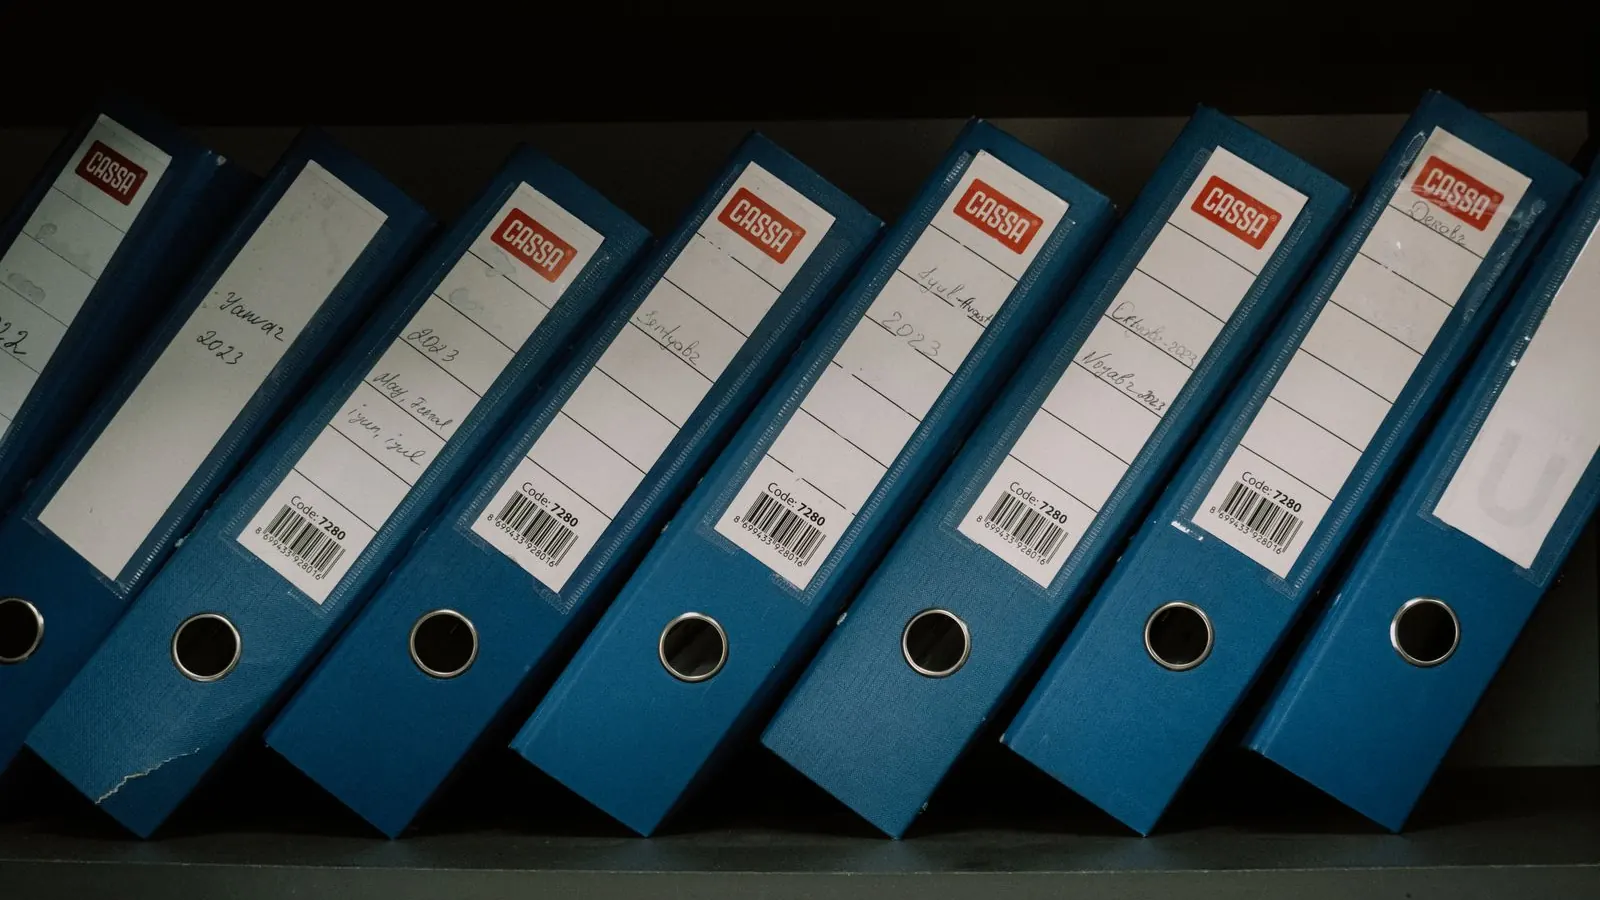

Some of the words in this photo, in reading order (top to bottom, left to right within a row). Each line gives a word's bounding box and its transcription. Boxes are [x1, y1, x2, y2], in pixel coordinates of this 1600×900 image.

[86, 151, 138, 196] CASSA
[1423, 168, 1491, 221] CASSA
[729, 199, 793, 253] CASSA
[965, 190, 1031, 244] CASSA
[1202, 187, 1268, 239] CASSA
[502, 219, 565, 272] CASSA
[196, 330, 244, 365] 2023
[406, 328, 460, 362] 2023
[881, 311, 942, 357] 2023
[522, 481, 551, 508] Code:
[550, 502, 579, 527] 7280
[767, 482, 797, 508] Code:
[797, 502, 826, 527] 7280
[1009, 481, 1039, 506] Code:
[1039, 500, 1068, 524] 7280
[1241, 471, 1273, 496] Code:
[1272, 489, 1302, 513] 7280
[290, 495, 319, 521] Code:
[318, 516, 346, 541] 7280
